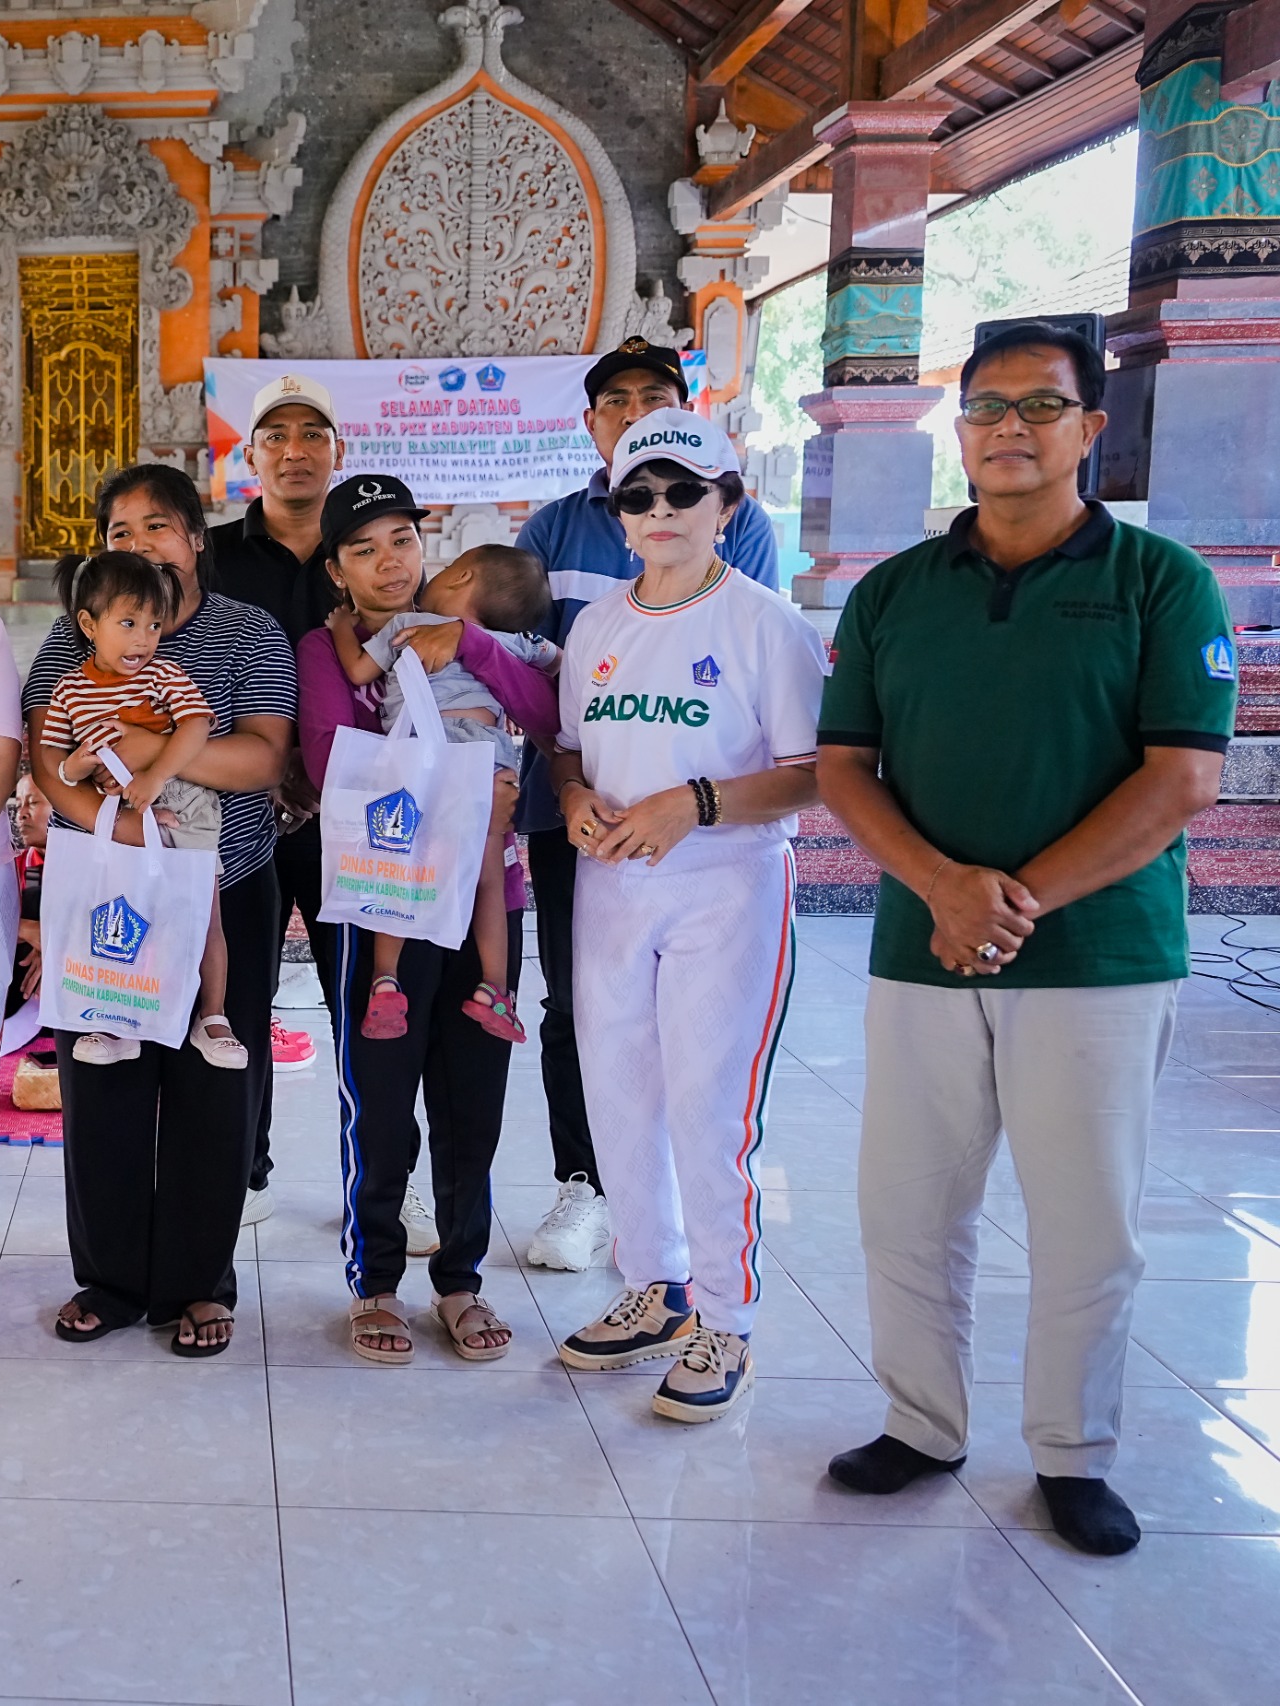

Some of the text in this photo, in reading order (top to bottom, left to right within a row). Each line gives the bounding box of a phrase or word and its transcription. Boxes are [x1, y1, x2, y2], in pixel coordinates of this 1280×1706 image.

[381, 398, 521, 417] SELAMAT DATANG
[375, 422, 396, 436] TP.
[400, 422, 428, 436] PKK
[431, 420, 512, 436] KABUPATEN
[517, 417, 577, 434] BADUNG
[501, 438, 531, 454] ADI
[536, 434, 593, 452] ARNAW
[629, 430, 703, 455] BADUNG
[379, 458, 417, 468] PEDULI
[420, 458, 448, 468] TEMU
[451, 456, 491, 468] WIRASA
[494, 456, 529, 467] KADER
[533, 455, 554, 464] PKK
[508, 467, 569, 479] KABUPATEN
[352, 497, 372, 511] FRED
[1060, 610, 1116, 623] BADUNG
[583, 693, 710, 728] BADUNG
[340, 854, 435, 883] DINAS PERIKANAN
[336, 875, 437, 902] PEMERINTAH KABUPATEN BADUNG
[375, 908, 416, 921] GEMARIKAN
[65, 957, 161, 994] DINAS PERIKANAN
[61, 976, 160, 1012] PEMERINTAH KABUPATEN BADUNG
[96, 1012, 138, 1026] GEMARIKAN
